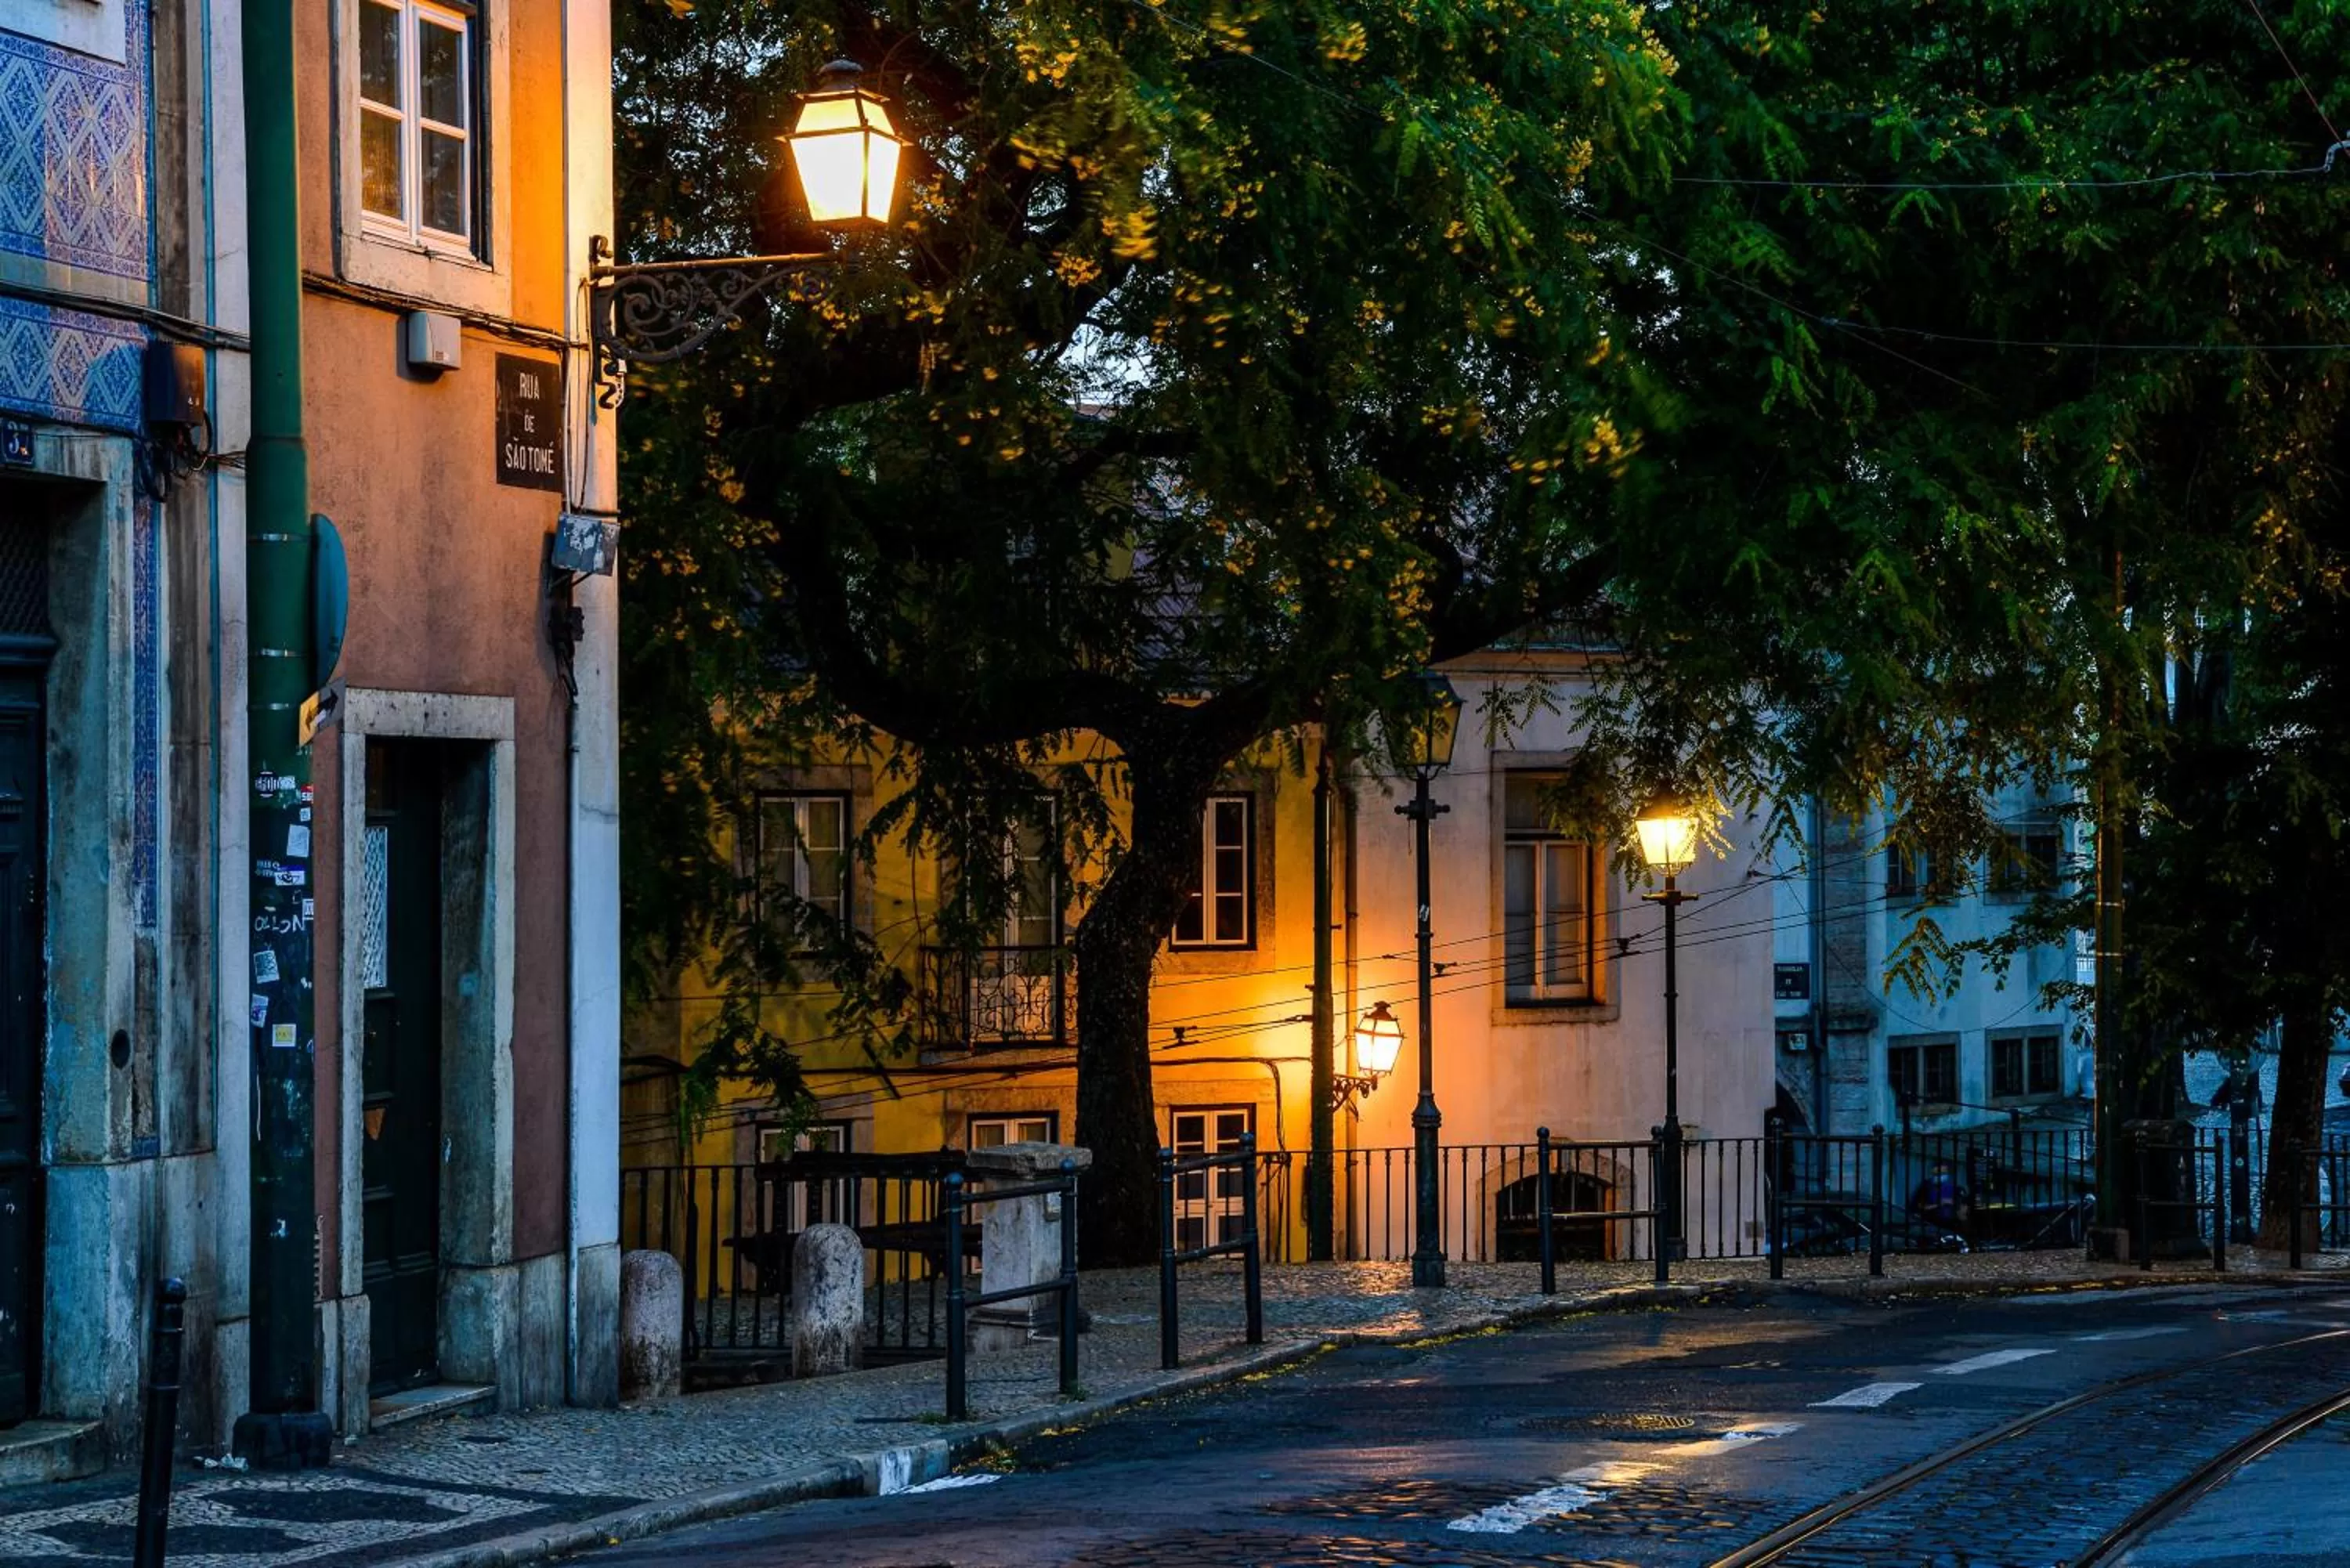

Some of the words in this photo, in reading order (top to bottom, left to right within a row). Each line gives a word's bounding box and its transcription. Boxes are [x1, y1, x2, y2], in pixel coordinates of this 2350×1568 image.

[519, 372, 540, 401] RUA
[524, 413, 535, 433] DE
[505, 437, 525, 471] SÃO
[527, 441, 555, 474] TOMÉ
